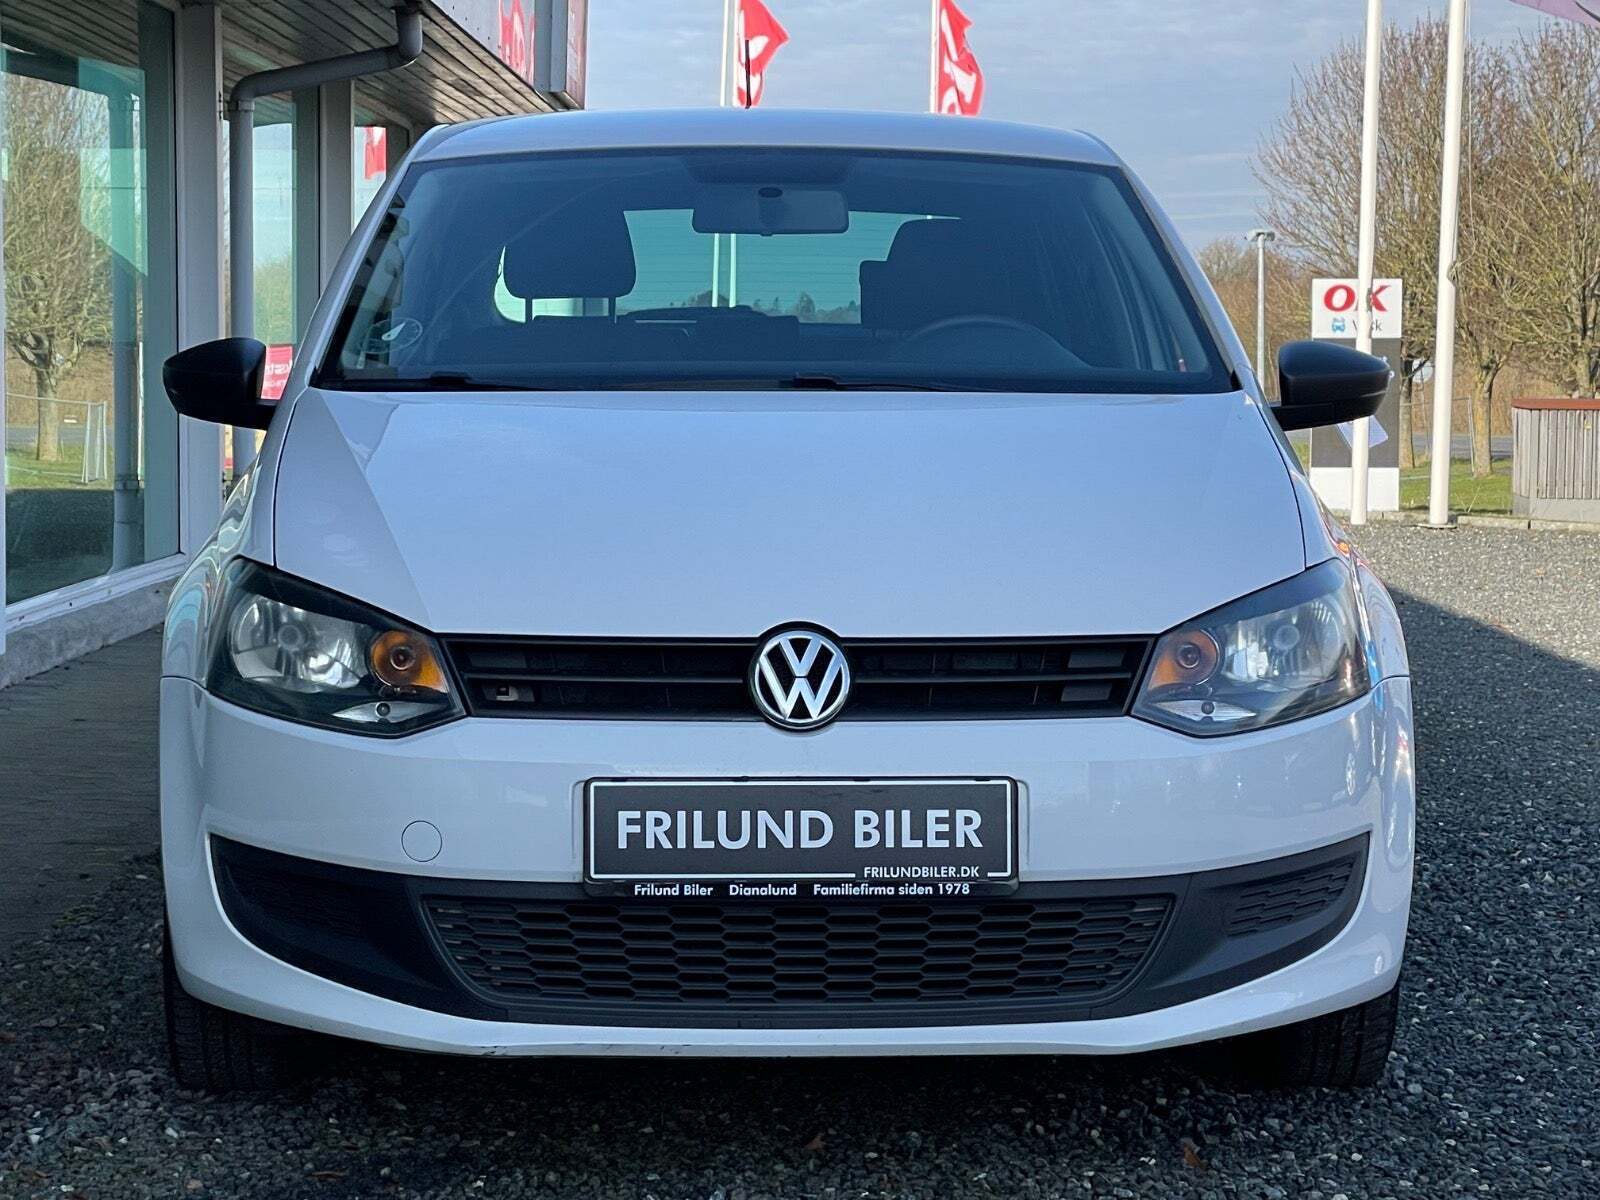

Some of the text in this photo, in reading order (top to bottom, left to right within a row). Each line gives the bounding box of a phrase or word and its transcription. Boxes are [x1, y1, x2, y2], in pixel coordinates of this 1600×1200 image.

[1323, 284, 1390, 312] OK
[617, 809, 984, 850] FRILUND BILER
[863, 866, 980, 878] FRILUNDBILER.DK
[634, 882, 970, 896] Frilund Biler Dianalund Familiefirma siden 1978
